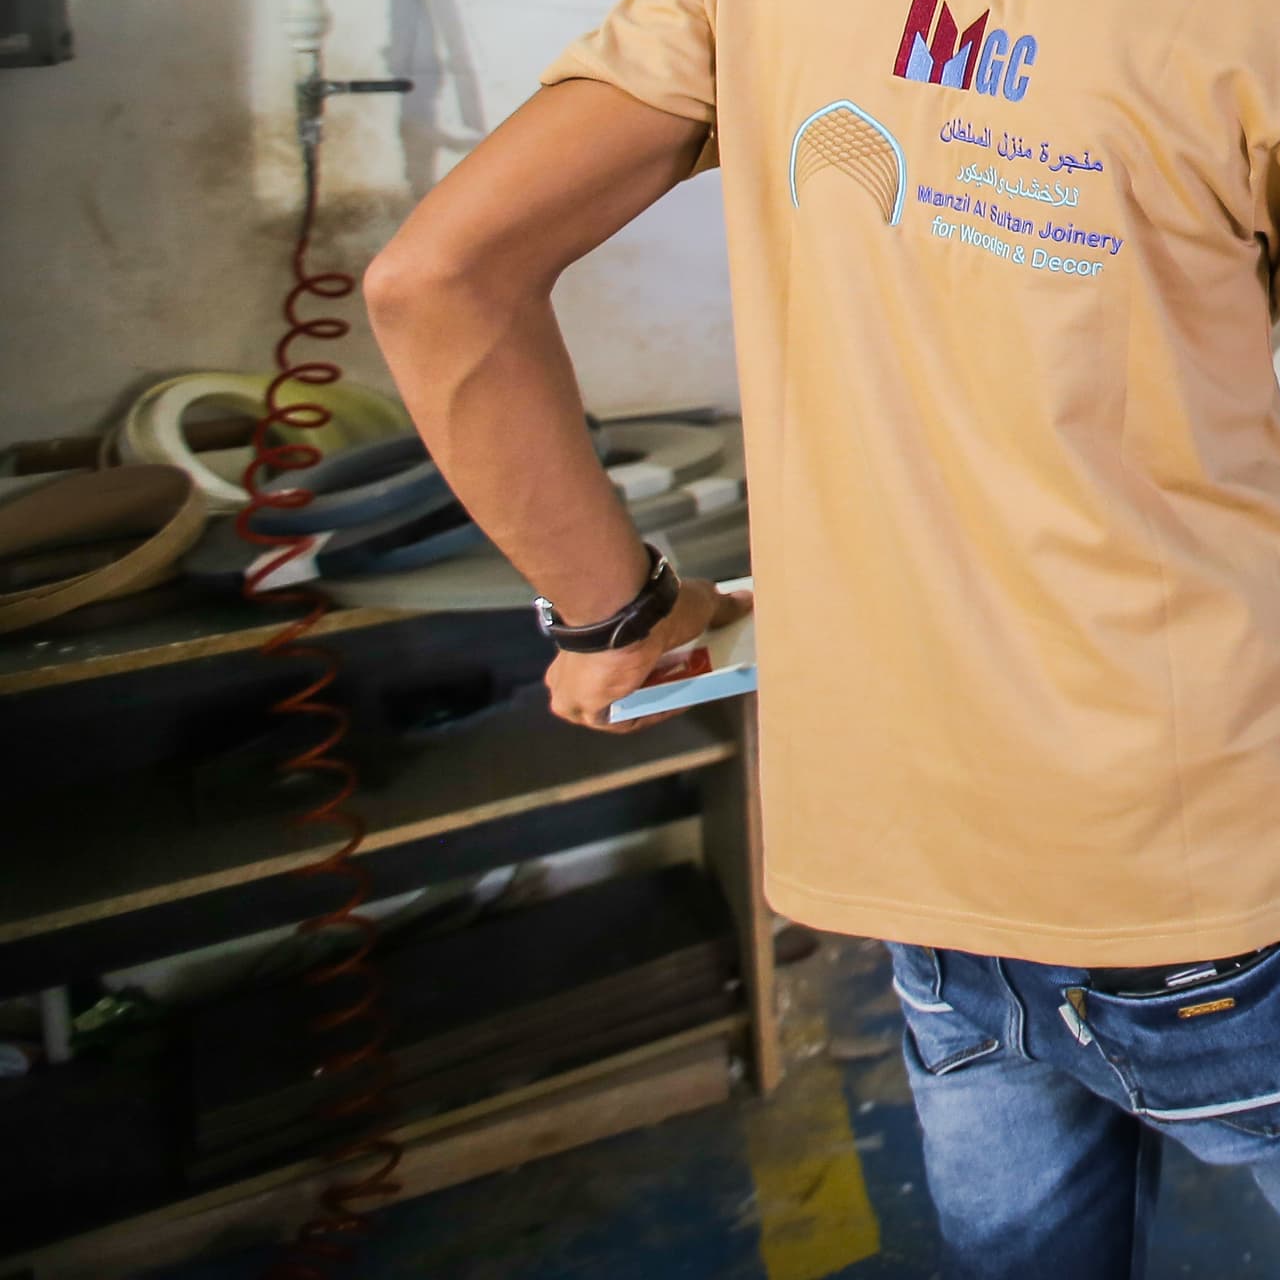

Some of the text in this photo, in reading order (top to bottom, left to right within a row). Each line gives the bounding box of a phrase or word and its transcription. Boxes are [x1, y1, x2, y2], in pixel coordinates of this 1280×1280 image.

[940, 117, 992, 148] السلطان
[997, 132, 1032, 160] منزل
[917, 185, 1124, 255] Manzil Al Sultan Joinery
[932, 215, 1103, 277] for Wooden & Decor
